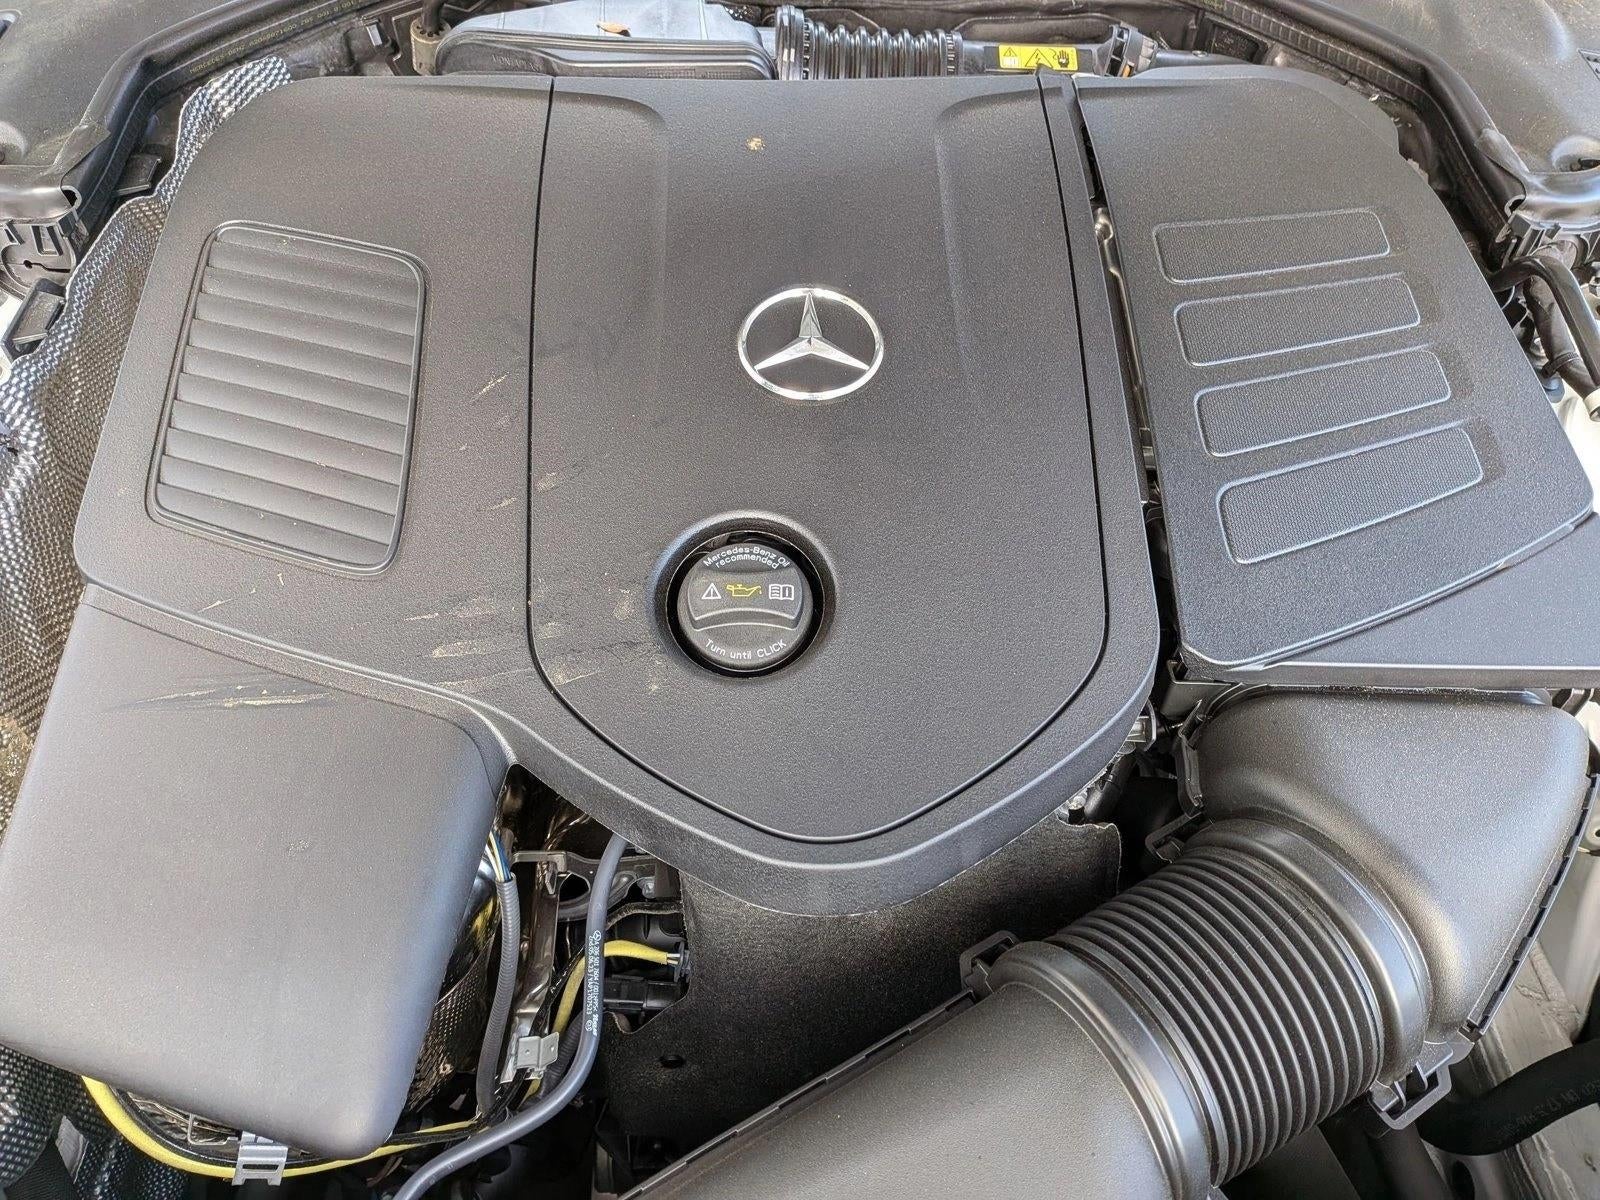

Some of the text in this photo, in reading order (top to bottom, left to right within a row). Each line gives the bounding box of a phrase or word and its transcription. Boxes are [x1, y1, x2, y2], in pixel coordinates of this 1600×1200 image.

[702, 546, 791, 567] Mercedes-Benz Oil
[715, 553, 781, 569] recommended
[705, 638, 787, 660] Turn until CLICK
